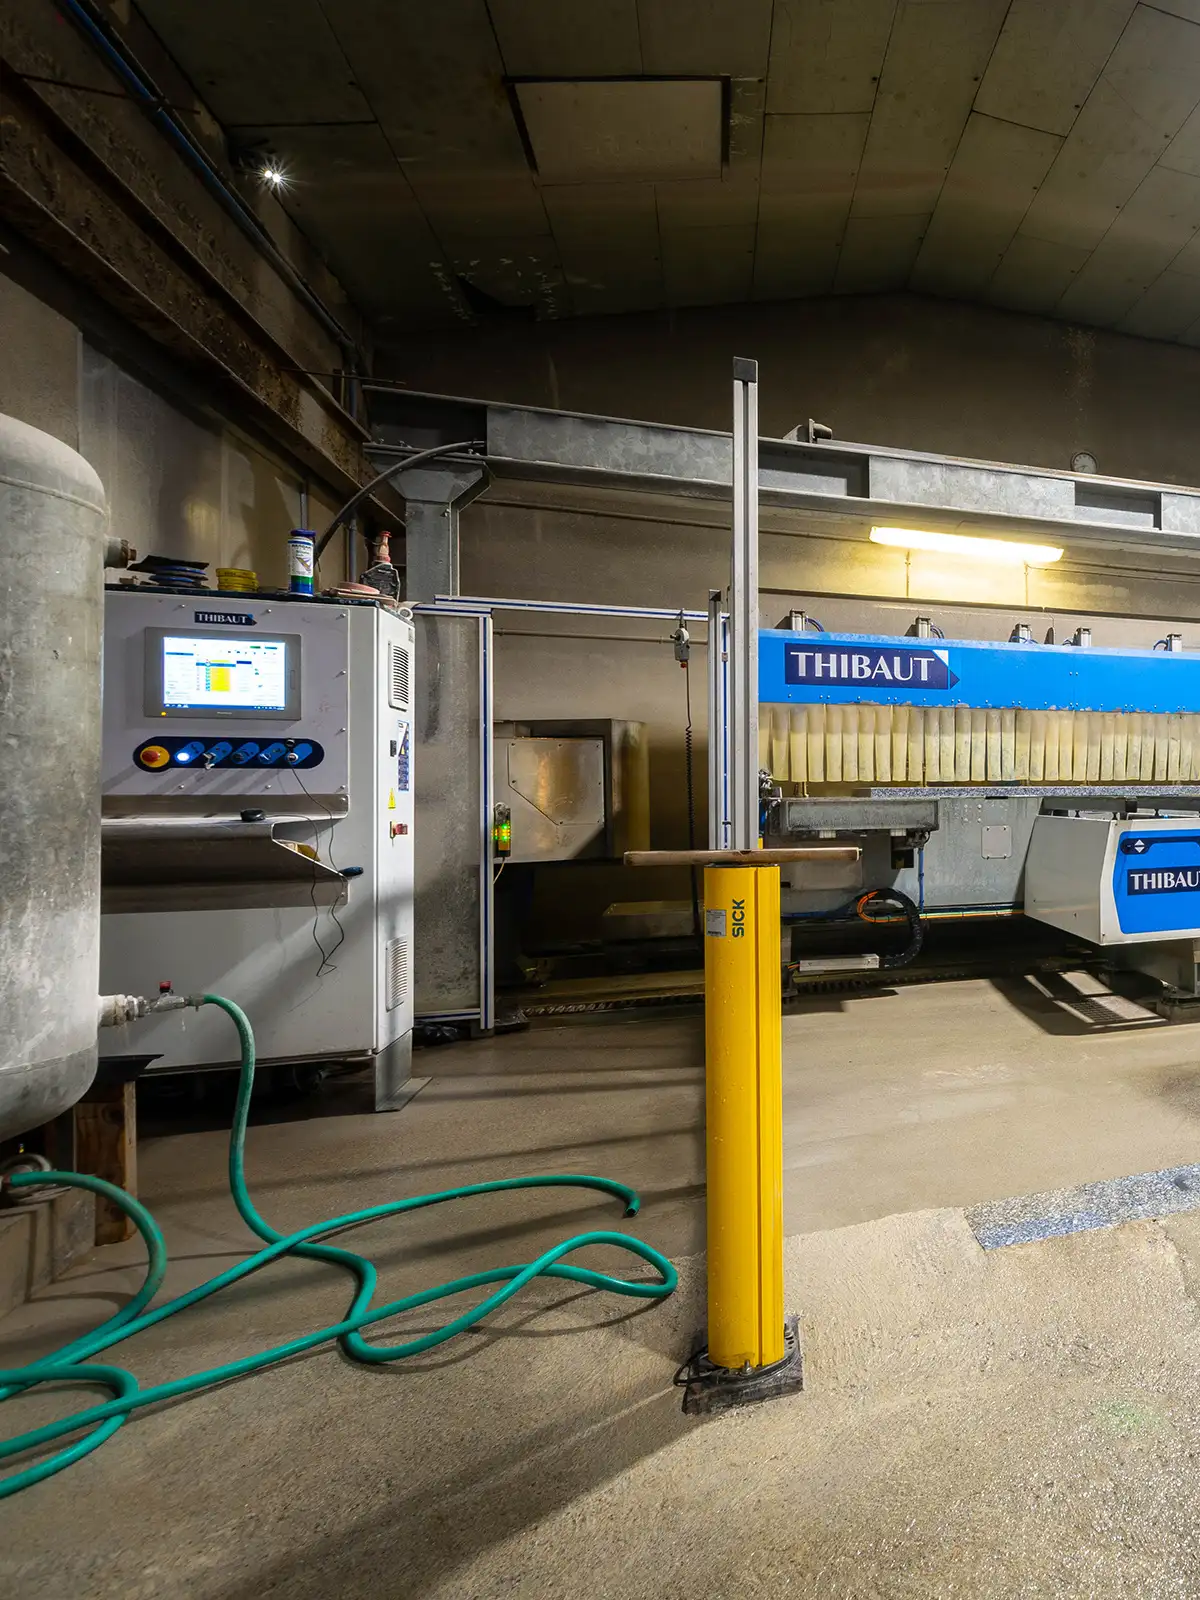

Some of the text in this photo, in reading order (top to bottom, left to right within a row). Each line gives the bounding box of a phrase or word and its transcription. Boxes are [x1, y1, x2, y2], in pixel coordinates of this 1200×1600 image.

[196, 613, 248, 624] THIBAUT
[790, 651, 935, 682] THIBAUT
[731, 898, 745, 938] SICK
